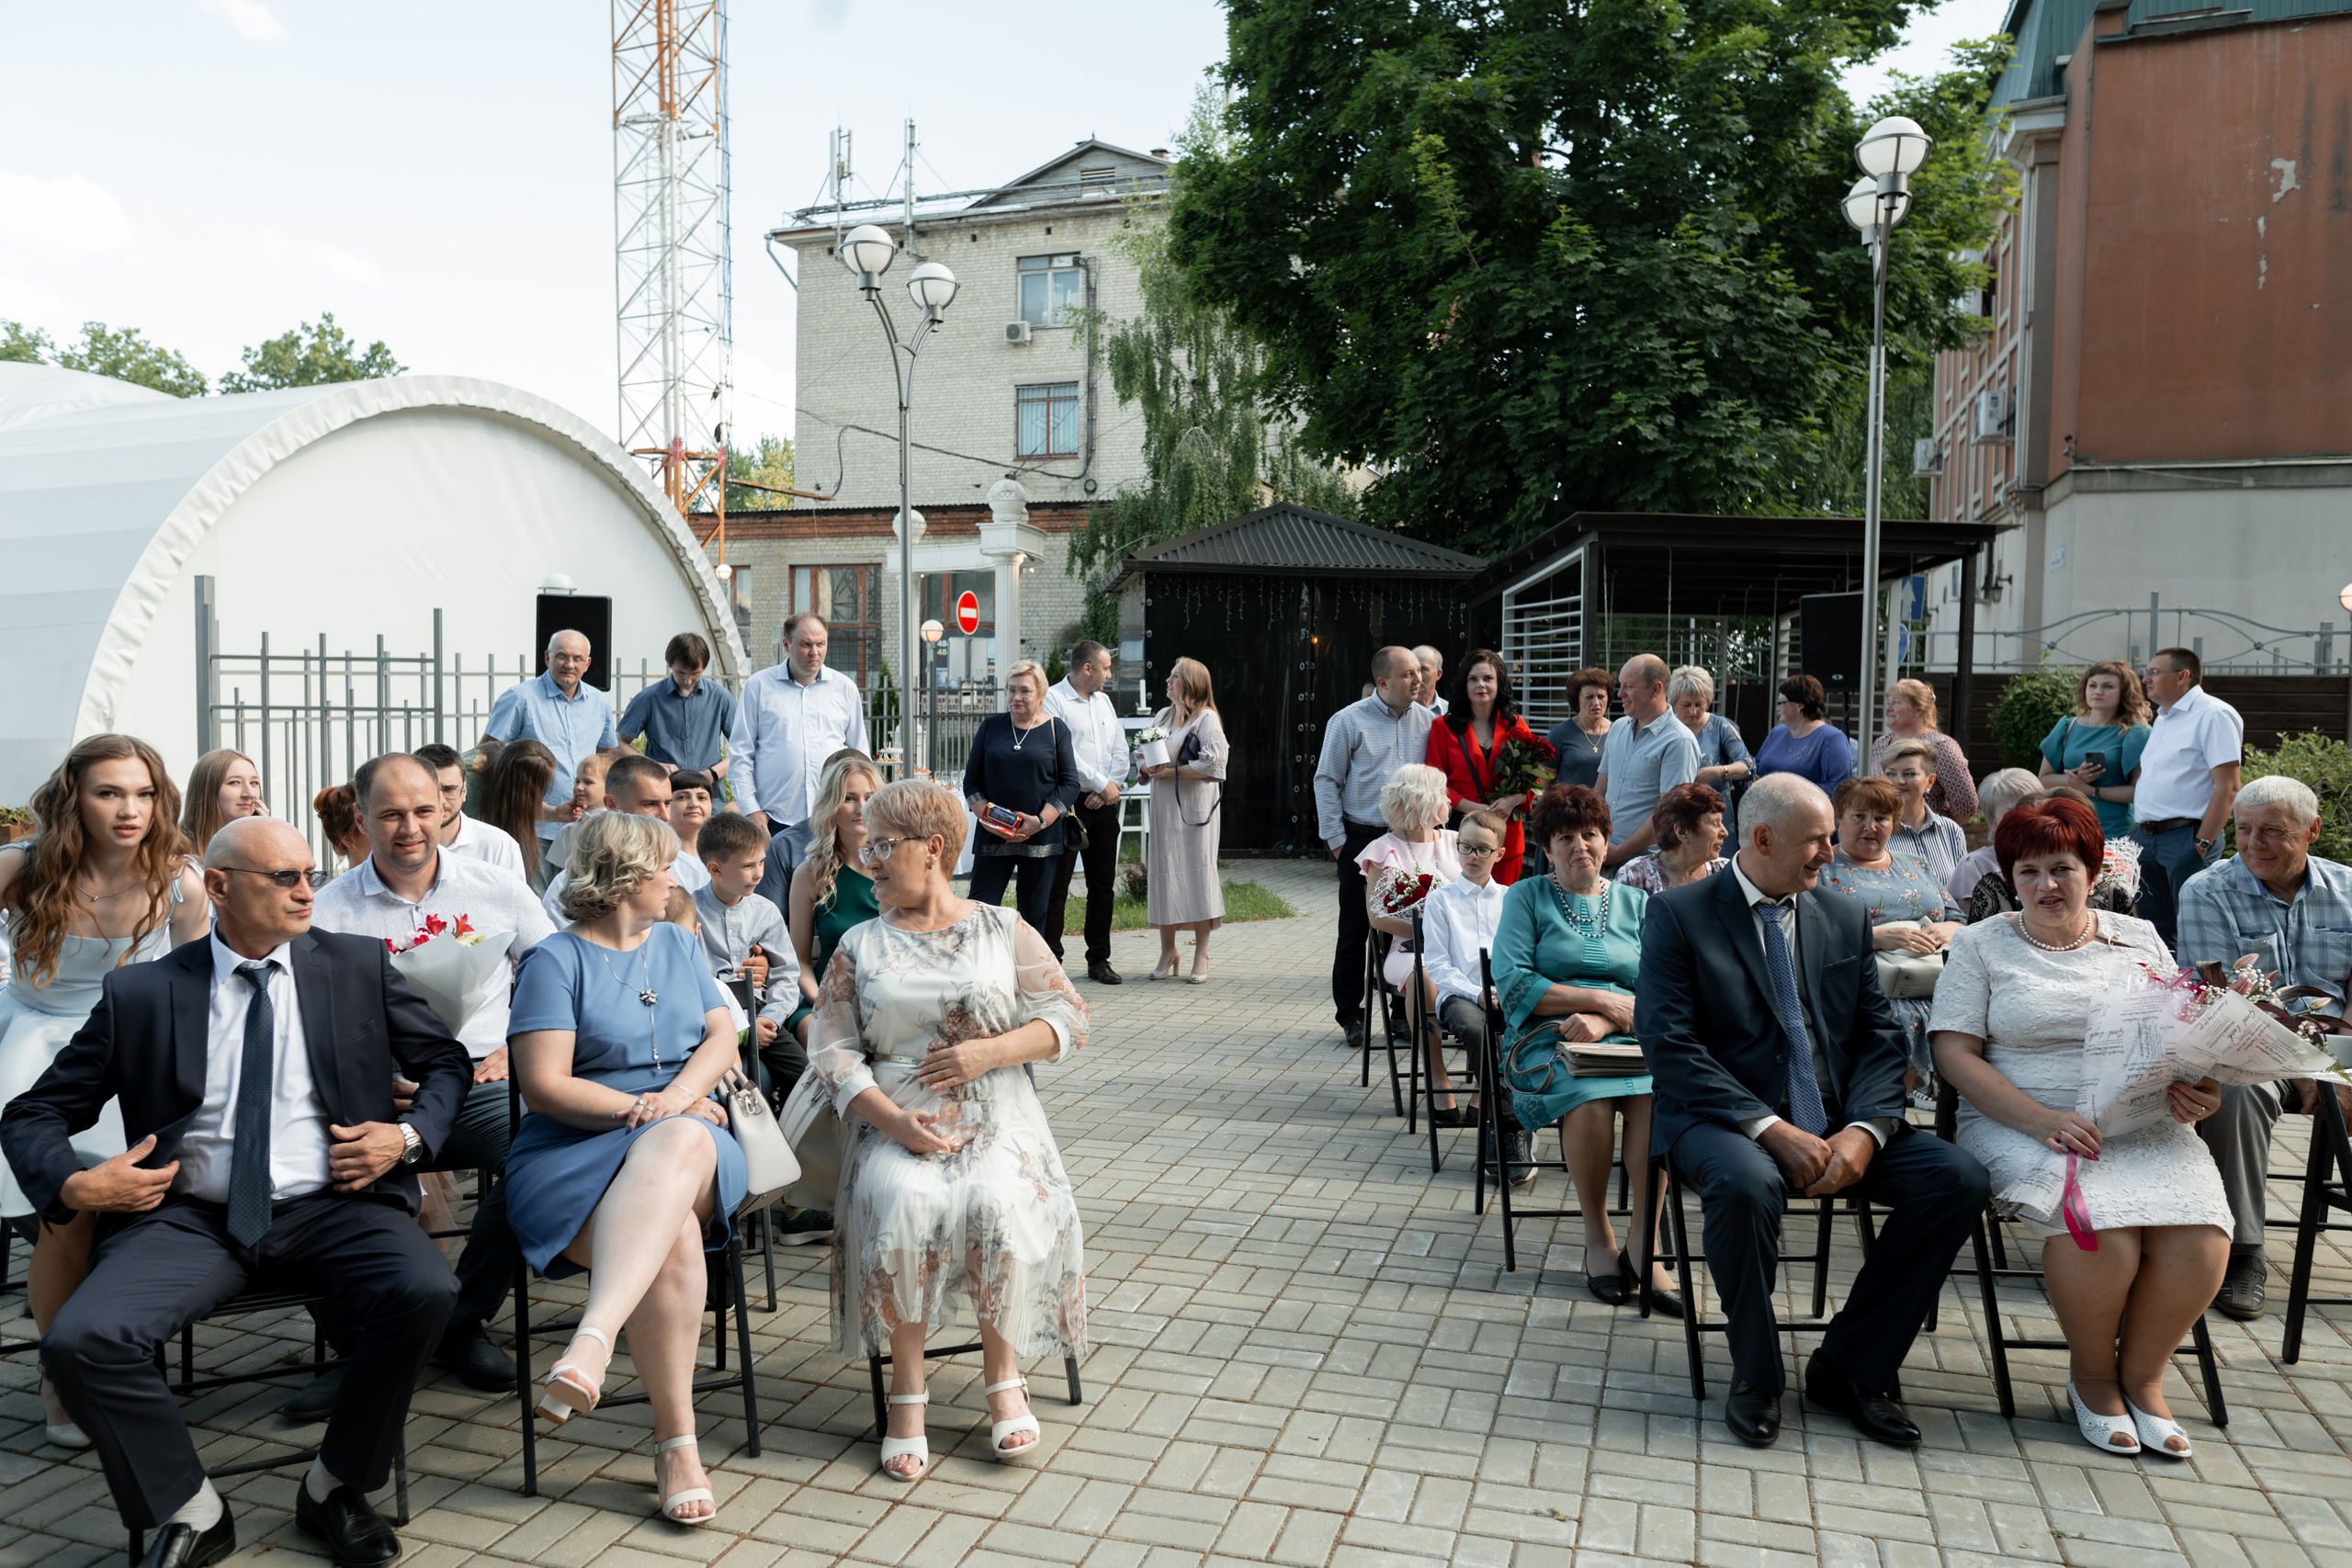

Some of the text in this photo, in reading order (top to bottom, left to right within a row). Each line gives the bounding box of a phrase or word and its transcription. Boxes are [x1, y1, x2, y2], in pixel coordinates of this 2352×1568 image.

[2243, 1010, 2256, 1026] Good
[2088, 1028, 2124, 1042] Good Luck
[2228, 1025, 2241, 1042] Luck
[2125, 1074, 2143, 1082] Luck
[2147, 1069, 2163, 1079] Good
[2148, 1089, 2162, 1100] Good
[2129, 1095, 2144, 1106] Luck
[2046, 1171, 2064, 1183] Good
